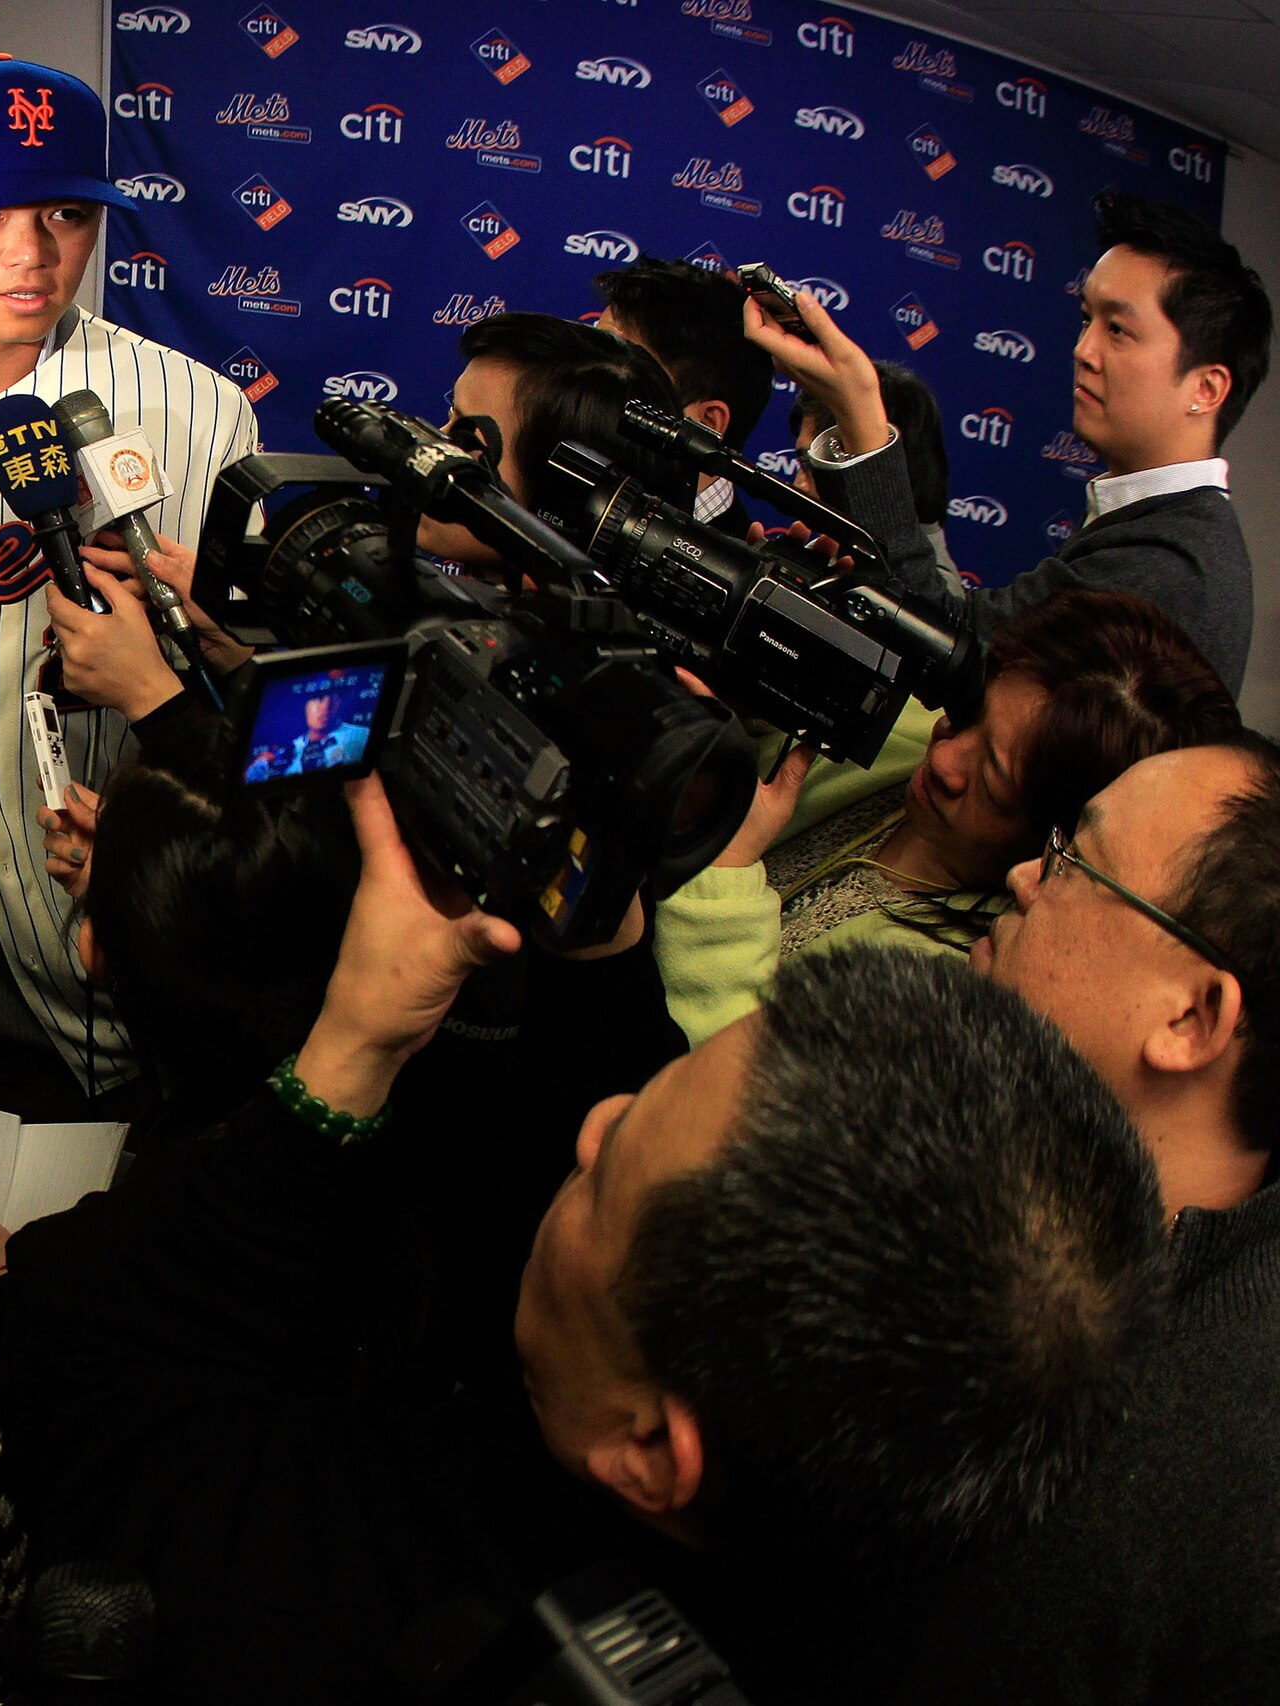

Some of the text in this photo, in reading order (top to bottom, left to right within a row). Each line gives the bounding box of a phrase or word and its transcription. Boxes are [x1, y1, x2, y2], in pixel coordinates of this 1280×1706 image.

[116, 9, 184, 34] SNY
[247, 16, 277, 35] citi
[267, 32, 295, 54] FIELD
[344, 27, 415, 53] SNY
[478, 42, 509, 61] citi
[797, 20, 854, 58] citi
[498, 58, 527, 82] FIELD
[576, 58, 644, 87] SNY
[115, 86, 172, 121] citi
[705, 82, 735, 103] citi
[996, 79, 1047, 118] citi
[216, 93, 290, 125] Mets
[795, 106, 859, 138] SNY
[251, 126, 308, 140] mets.com
[340, 106, 402, 144] citi
[446, 119, 520, 150] Mets
[481, 153, 538, 169] mets.com
[570, 139, 632, 178] citi
[1169, 147, 1212, 183] citi
[114, 176, 180, 201] SNY
[672, 158, 744, 192] Mets
[240, 187, 271, 207] citi
[787, 189, 845, 227] citi
[260, 204, 288, 227] FIELD
[337, 199, 406, 226] SNY
[469, 214, 500, 235] citi
[881, 209, 945, 245] Mets
[488, 233, 516, 255] FIELD
[564, 232, 633, 261] SNY
[109, 254, 167, 290] citi
[983, 243, 1035, 282] citi
[208, 266, 280, 296] Mets
[242, 299, 298, 314] mets.com
[329, 281, 391, 318] citi
[973, 330, 1031, 361] SNY
[229, 360, 259, 379] citi
[247, 377, 275, 400] FIELD
[323, 373, 391, 400] SNY
[960, 410, 1012, 448] citi
[2, 443, 71, 491] 東森
[536, 508, 565, 529] LEICA
[947, 497, 1004, 525] SNY
[672, 537, 702, 561] 3CCD
[759, 630, 800, 660] Panasonic
